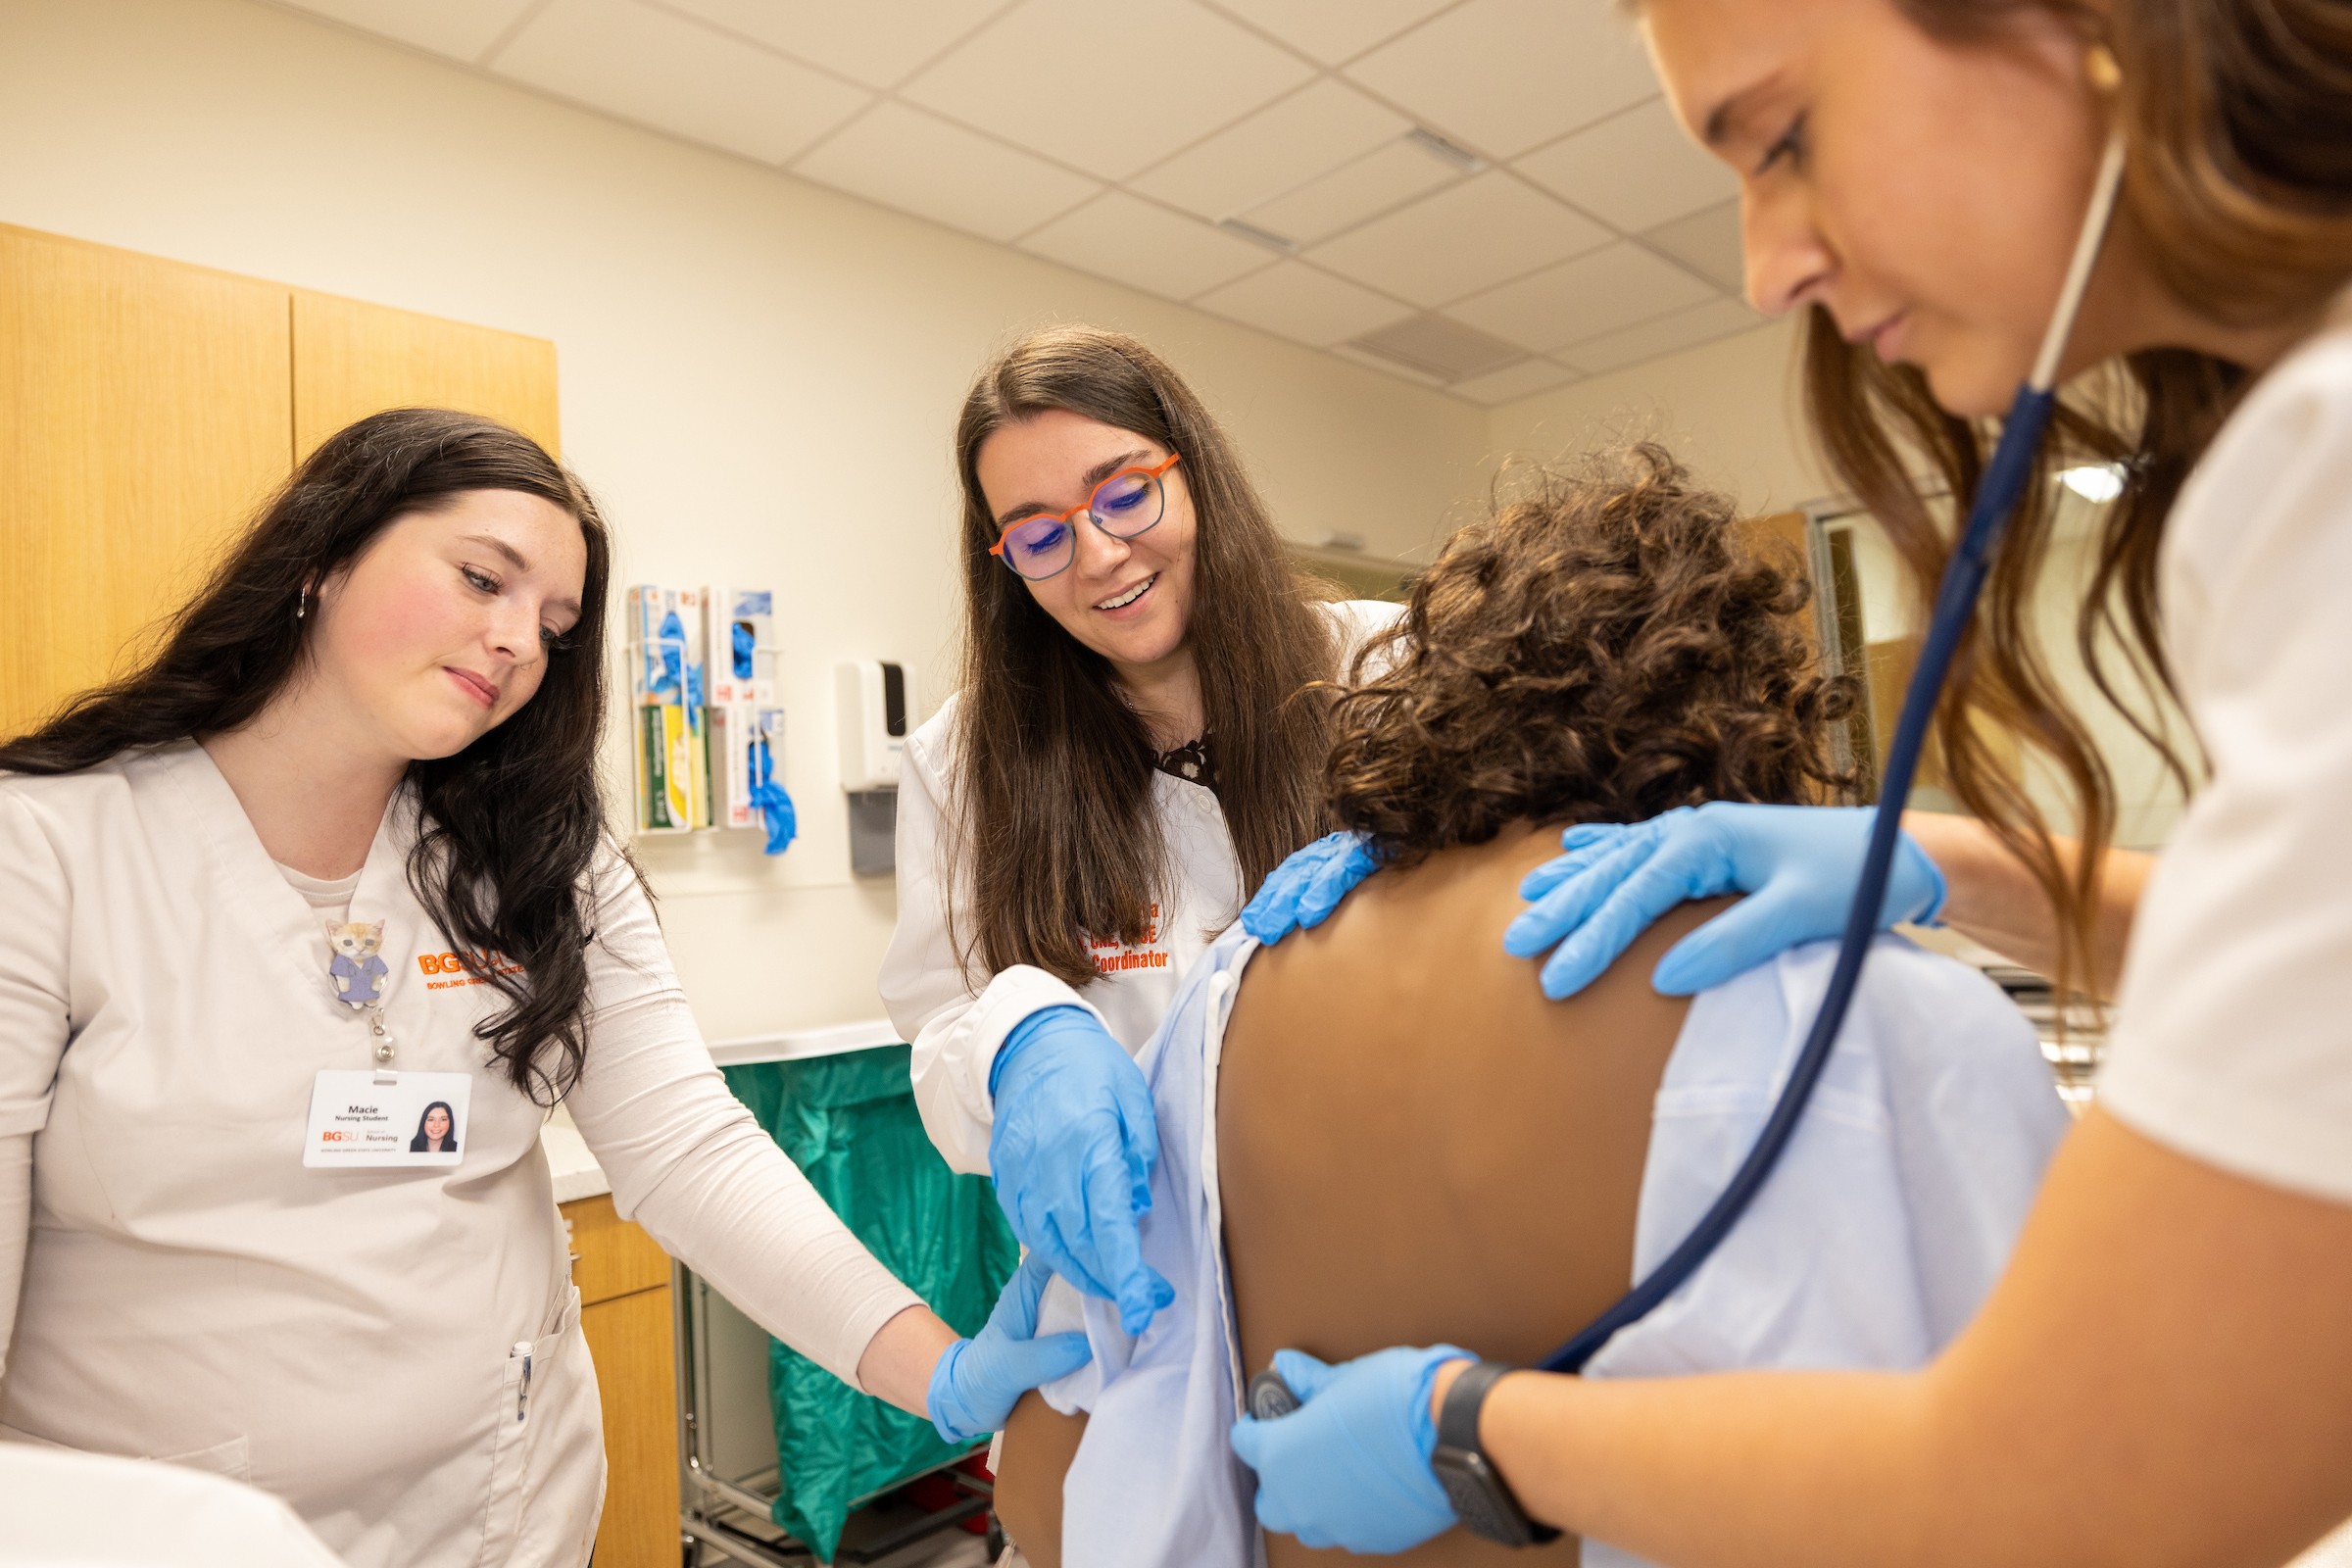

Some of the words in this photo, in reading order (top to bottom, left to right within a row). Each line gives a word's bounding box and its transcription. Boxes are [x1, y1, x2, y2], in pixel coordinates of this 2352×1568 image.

[1092, 950, 1168, 972] Coordinator
[426, 979, 466, 990] BOWLING
[348, 1105, 378, 1114] Macie
[322, 1131, 359, 1142] BGSU
